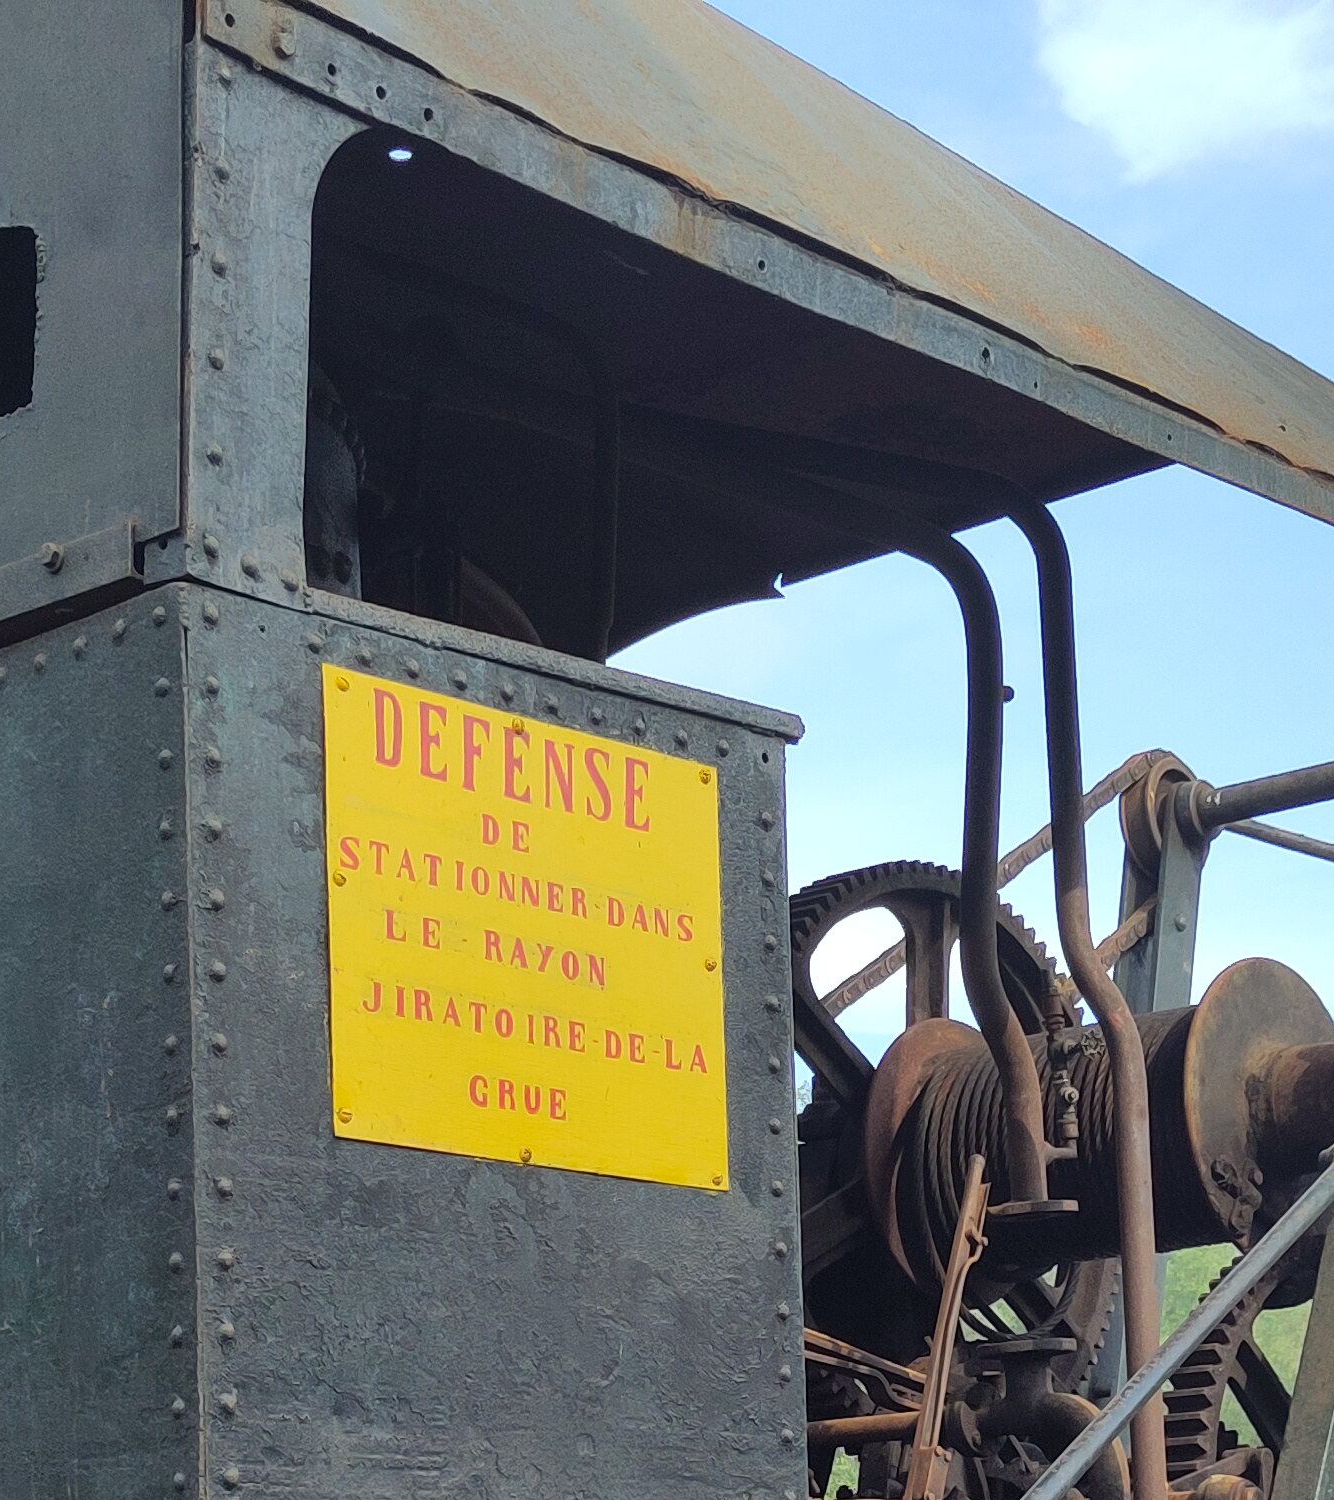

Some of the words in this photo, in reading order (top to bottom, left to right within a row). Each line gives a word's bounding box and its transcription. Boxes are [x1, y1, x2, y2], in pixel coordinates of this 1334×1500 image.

[372, 687, 652, 833] DEFENSE
[480, 813, 531, 854] DE
[339, 836, 588, 920] STATIONNER
[606, 895, 694, 942] DANS
[384, 909, 442, 950] LE
[483, 929, 606, 986] RAYON
[362, 981, 587, 1053] JIRATOIRE
[605, 1029, 647, 1064] DE
[664, 1038, 709, 1075] LA
[468, 1074, 568, 1122] GRUE
